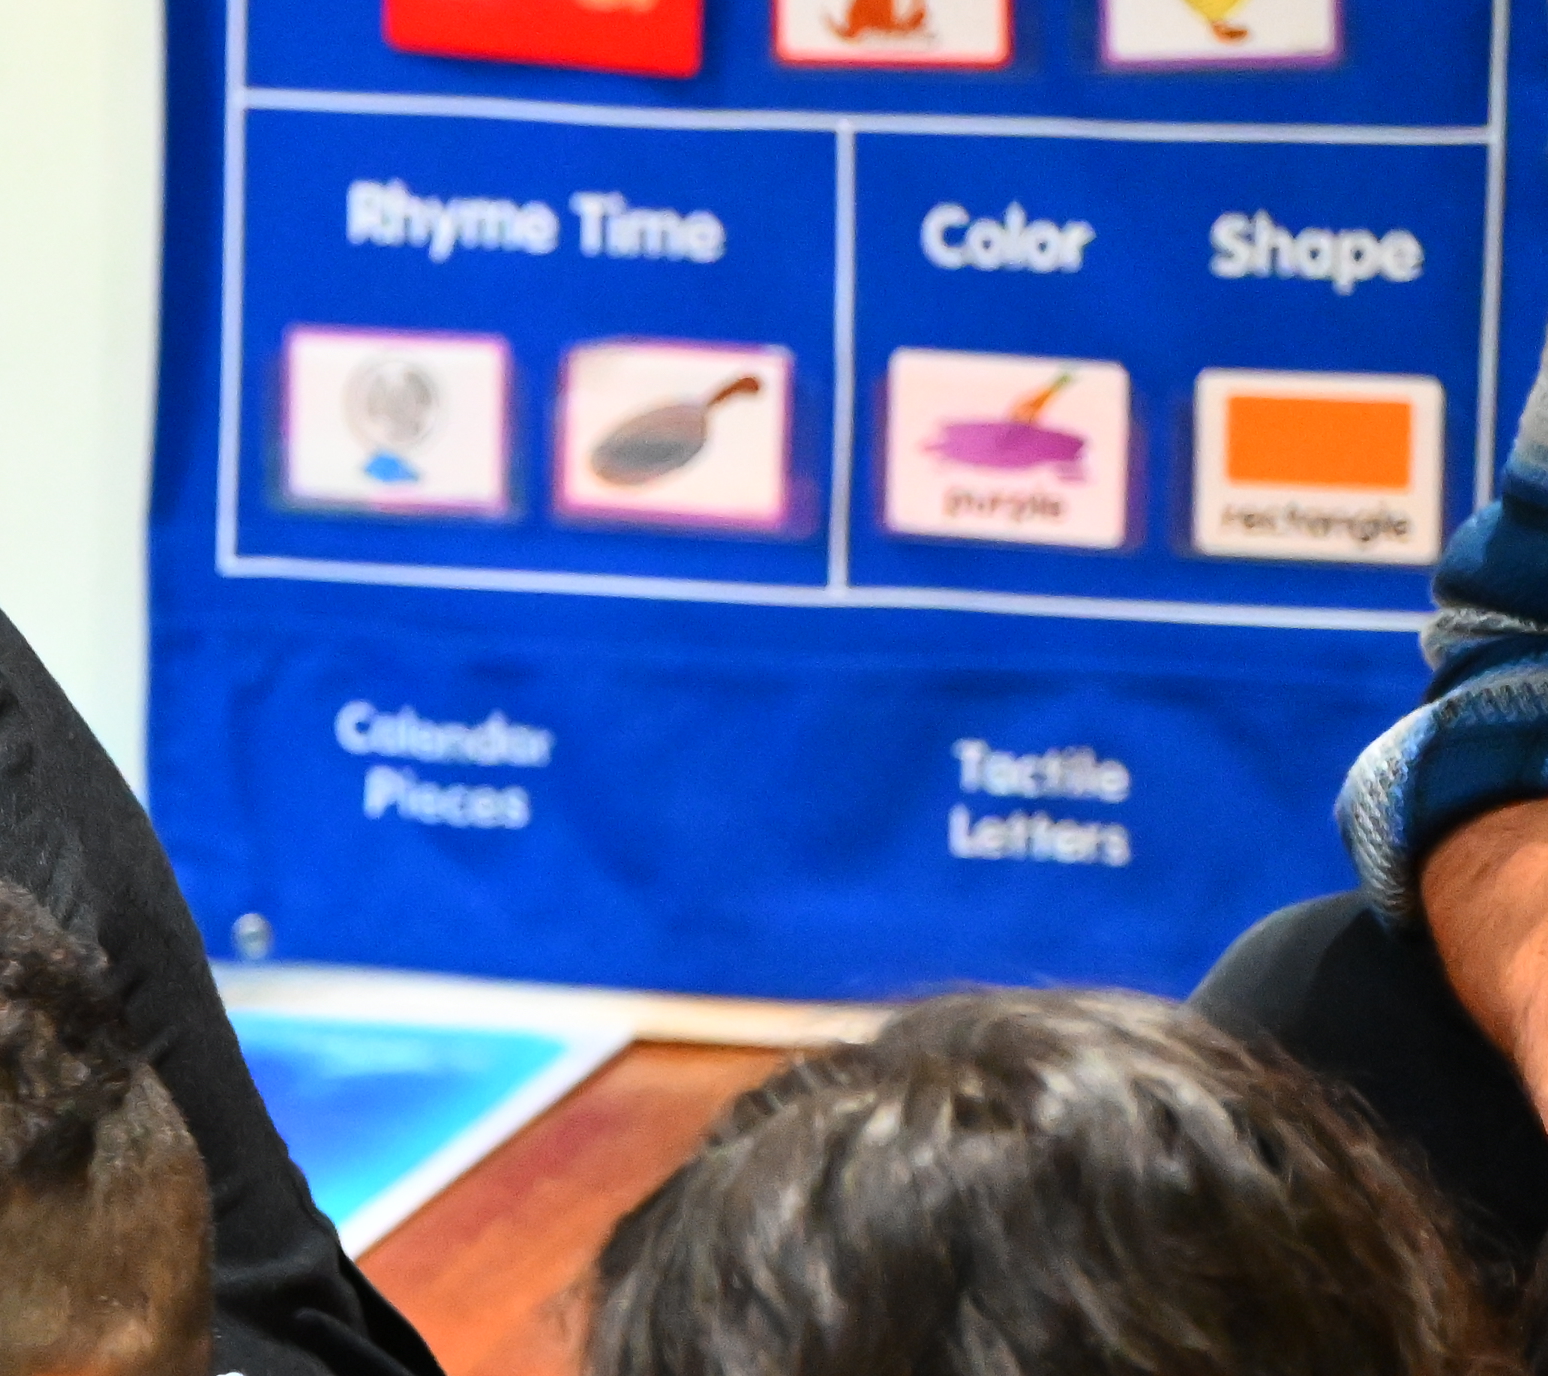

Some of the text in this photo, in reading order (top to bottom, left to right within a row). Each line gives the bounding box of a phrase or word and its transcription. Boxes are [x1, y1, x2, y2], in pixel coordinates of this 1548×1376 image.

[346, 177, 725, 264] Rhyme Time
[921, 200, 1096, 273] Color
[1210, 209, 1424, 296] Shape
[1222, 501, 1410, 549] rectangle
[334, 700, 554, 768] Calendar
[363, 764, 530, 830] Pieces
[951, 737, 1131, 804] Tactile
[948, 803, 1131, 868] Letters
